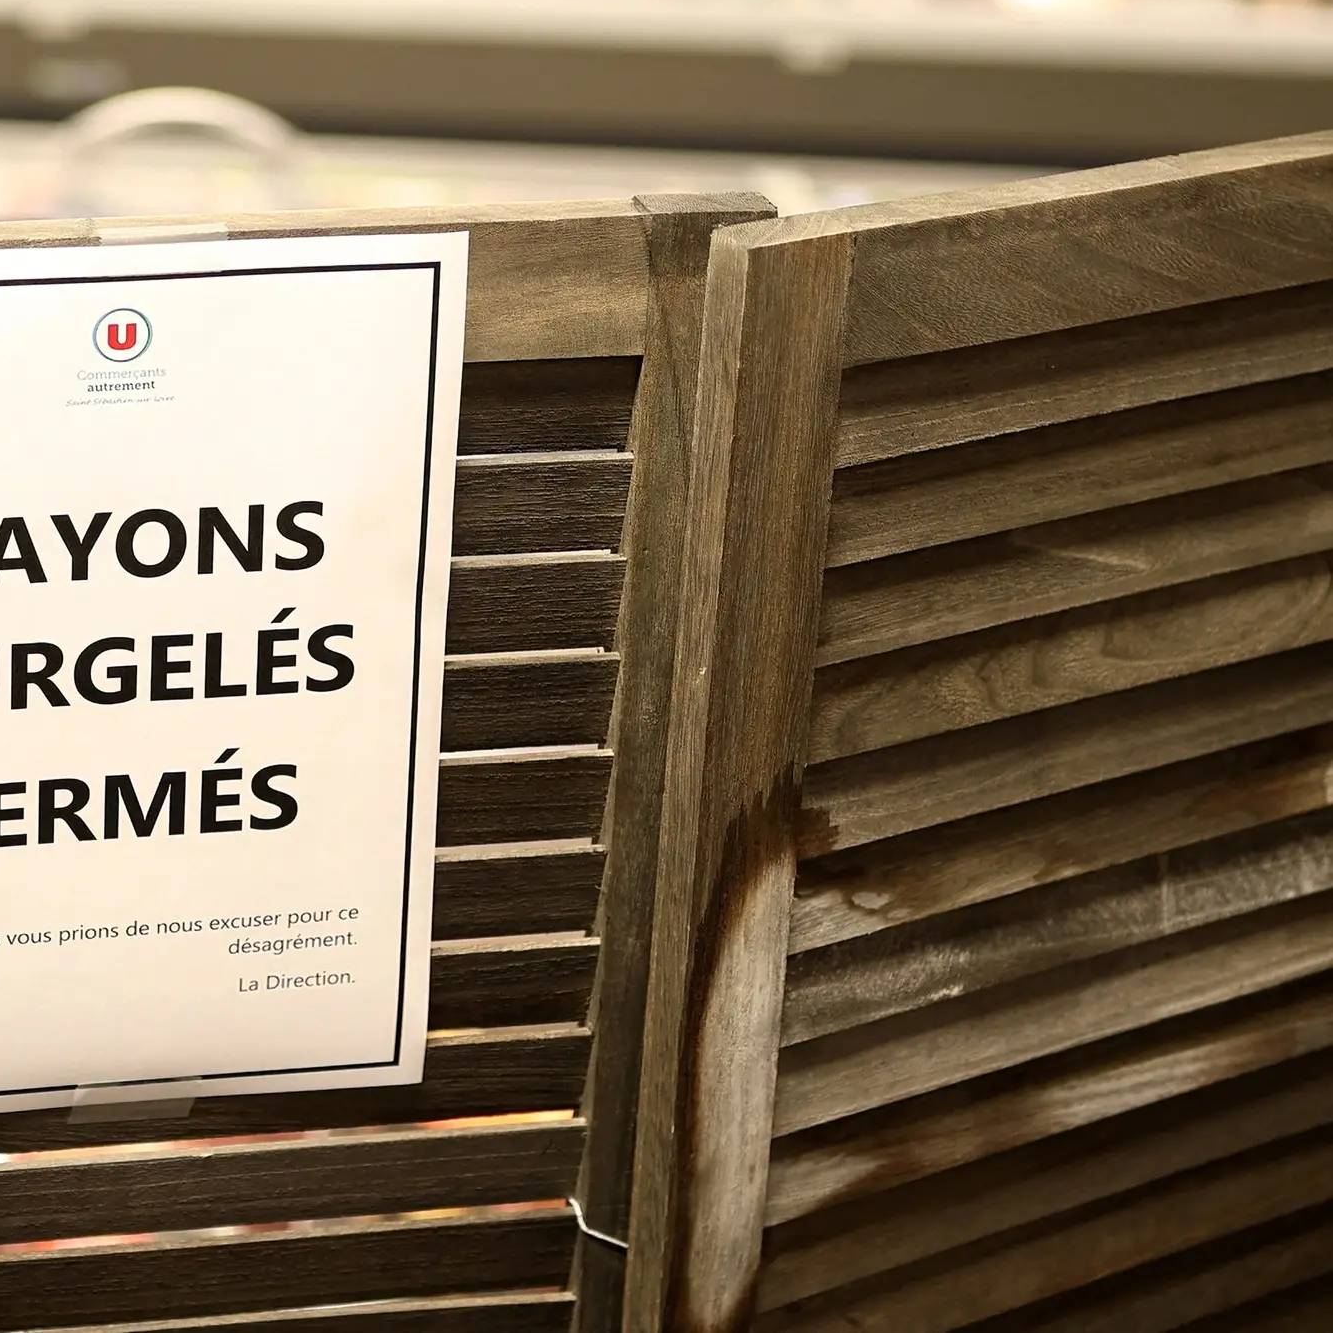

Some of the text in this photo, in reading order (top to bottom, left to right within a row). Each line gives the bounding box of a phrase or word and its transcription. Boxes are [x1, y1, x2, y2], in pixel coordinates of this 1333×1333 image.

[108, 323, 137, 350] U
[76, 367, 167, 381] Commerçants
[87, 380, 155, 392] autrement
[6, 931, 52, 946] vous
[59, 924, 119, 946] prions
[125, 920, 150, 937] de
[157, 920, 203, 935] nous
[209, 913, 282, 931] excuser
[287, 909, 333, 929] pour
[338, 907, 359, 921] ce
[228, 931, 358, 956] désagrément.
[239, 970, 356, 993] La Direction.
